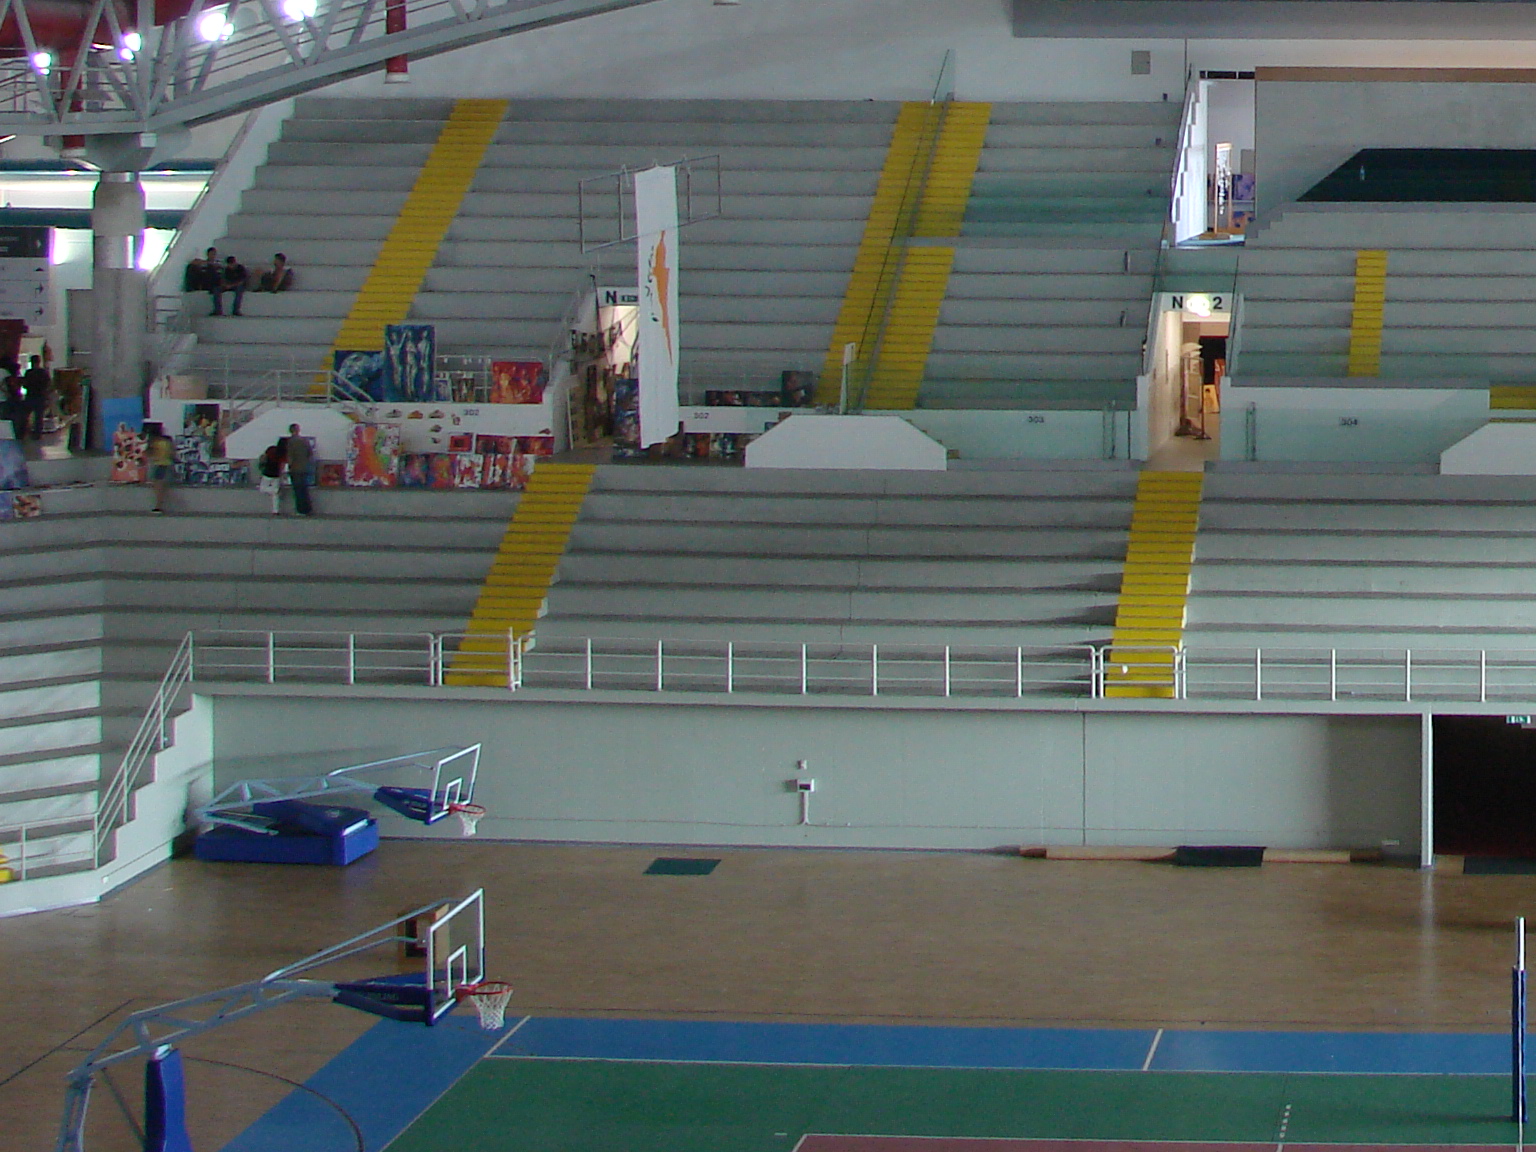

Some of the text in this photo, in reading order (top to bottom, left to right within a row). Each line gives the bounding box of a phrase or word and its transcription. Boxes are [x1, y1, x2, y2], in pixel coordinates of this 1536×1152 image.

[605, 290, 617, 304] N
[1172, 295, 1223, 310] N 2
[463, 409, 480, 417] 302
